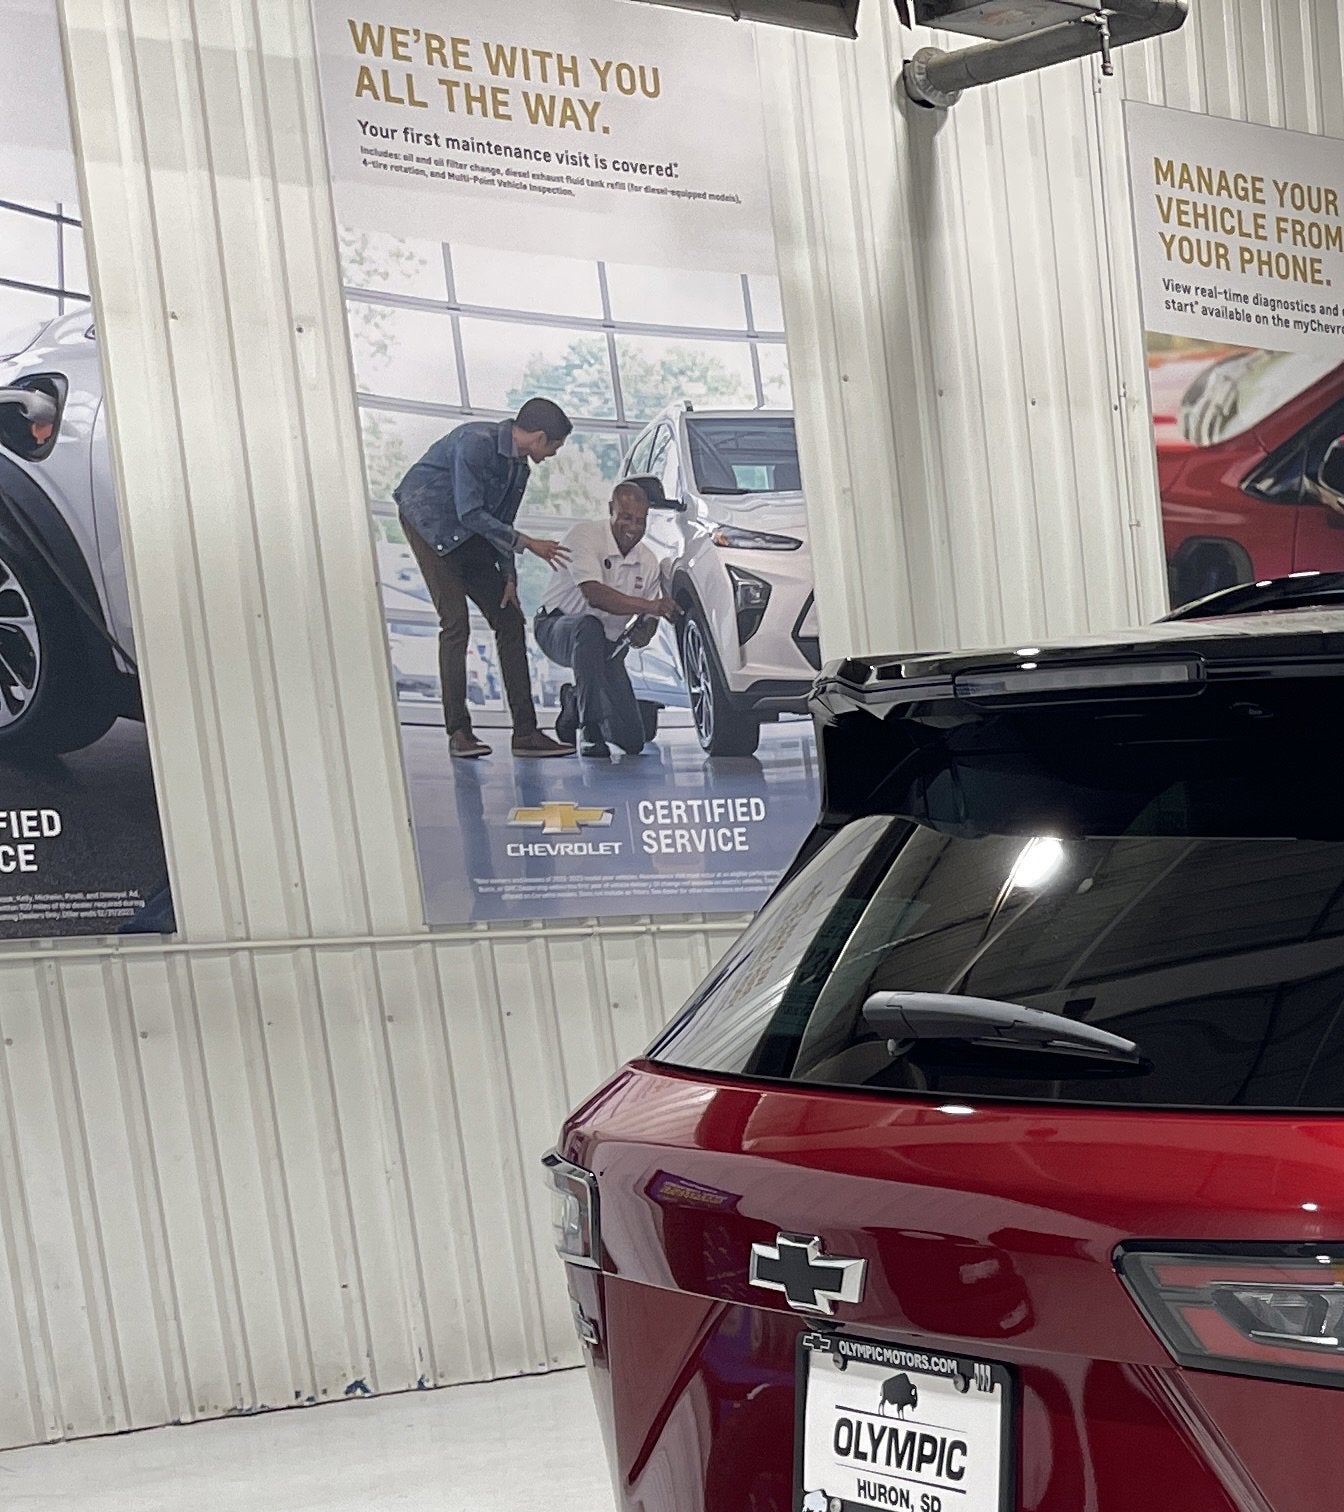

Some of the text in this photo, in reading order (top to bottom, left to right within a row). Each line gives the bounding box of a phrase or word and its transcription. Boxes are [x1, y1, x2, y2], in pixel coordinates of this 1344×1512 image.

[347, 19, 660, 98] WE'RE WITH YOU
[355, 66, 611, 134] ALL THE WAY.
[357, 119, 398, 140] Your
[403, 127, 441, 147] first
[446, 137, 551, 162] maintenance
[555, 150, 590, 168] visit
[594, 154, 607, 169] is
[416, 156, 431, 165] and
[430, 170, 445, 180] and
[1153, 157, 1339, 217] MANAGE YOUR
[1156, 194, 1344, 252] VEHICLE FROM
[1158, 231, 1332, 286] YOUR PHONE.
[1162, 278, 1191, 295] View
[1194, 285, 1249, 304] real-time
[1253, 292, 1316, 314] diagnostics
[1319, 304, 1338, 316] and
[1201, 305, 1251, 323] available
[1255, 313, 1268, 325] on
[1272, 315, 1290, 329] the
[638, 797, 766, 825] CERTIFIED
[506, 842, 622, 857] CHEVROLET
[642, 827, 749, 854] SERVICE
[838, 1340, 957, 1374] OLYMPICMOTORS.COM
[833, 1417, 968, 1482] OLYMPIC
